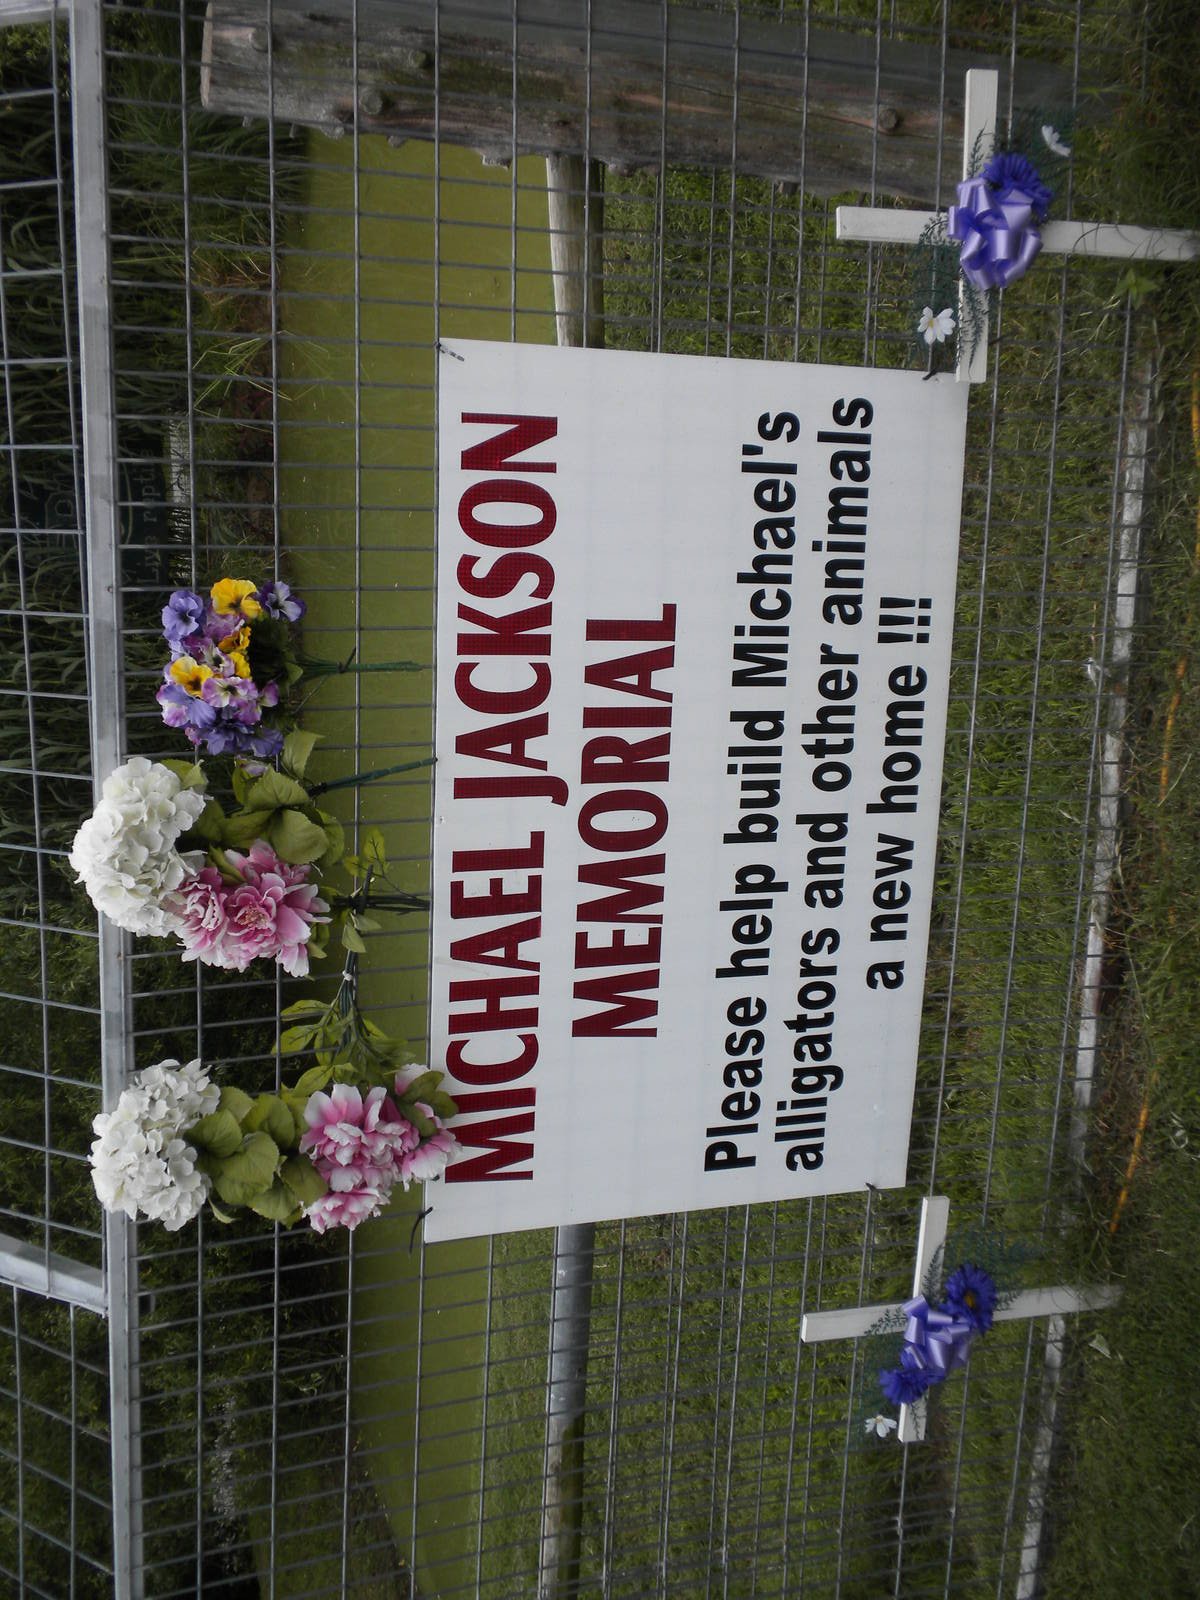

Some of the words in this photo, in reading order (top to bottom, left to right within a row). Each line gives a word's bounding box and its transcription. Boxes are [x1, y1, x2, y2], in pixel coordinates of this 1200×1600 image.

[731, 411, 800, 687] Michael's
[811, 397, 874, 626] animals
[454, 412, 570, 806] JACKSON
[877, 596, 932, 644] !!!
[724, 710, 785, 844] build
[801, 642, 860, 792] other
[866, 664, 929, 815] home
[571, 602, 677, 1038] MEMORIAL
[795, 812, 849, 908] and
[870, 832, 916, 942] new
[715, 863, 789, 979] help
[866, 960, 905, 990] a
[445, 831, 545, 1182] MICHAEL
[775, 927, 844, 1171] alligators
[704, 996, 767, 1171] Please
